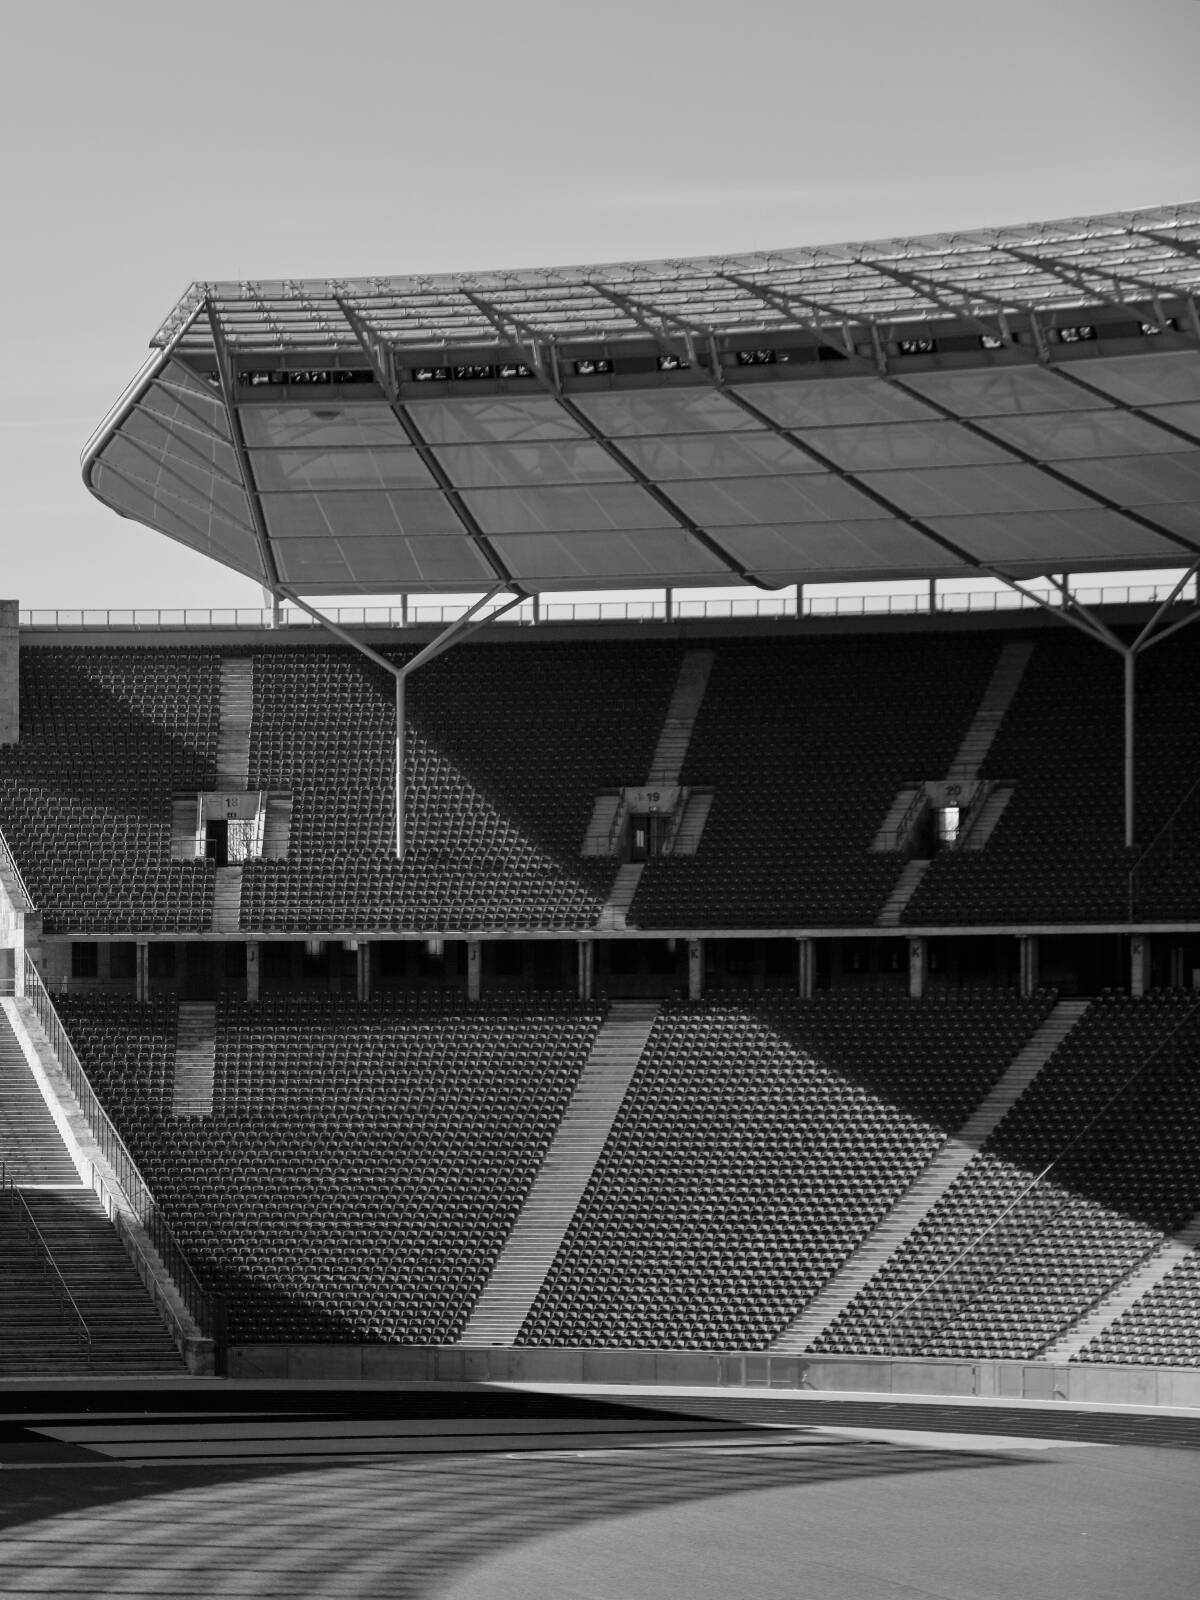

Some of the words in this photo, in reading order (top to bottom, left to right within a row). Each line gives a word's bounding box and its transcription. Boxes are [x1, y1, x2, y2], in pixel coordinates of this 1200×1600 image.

[945, 785, 961, 796] 20
[647, 791, 660, 802] 19
[225, 798, 238, 808] 18
[912, 946, 920, 958] K
